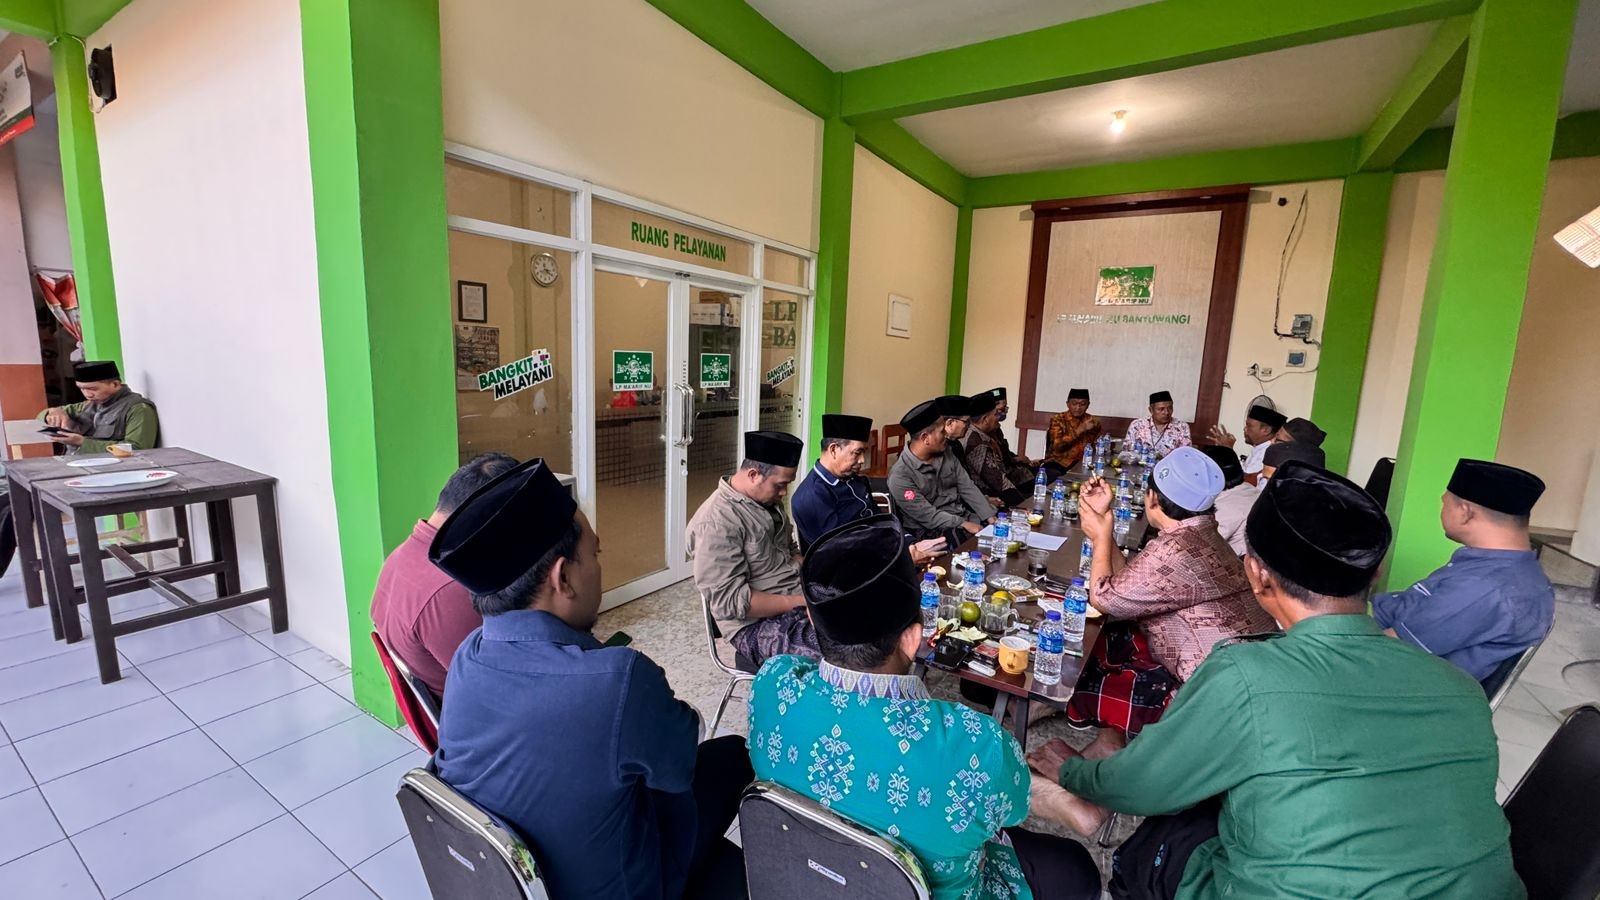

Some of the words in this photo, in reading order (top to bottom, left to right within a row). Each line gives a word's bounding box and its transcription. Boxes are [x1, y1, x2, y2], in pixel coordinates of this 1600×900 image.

[631, 221, 669, 248] RUANG
[674, 232, 727, 262] PELAYANAN
[478, 356, 533, 389] BANGKIT
[495, 364, 552, 399] MELAYANI
